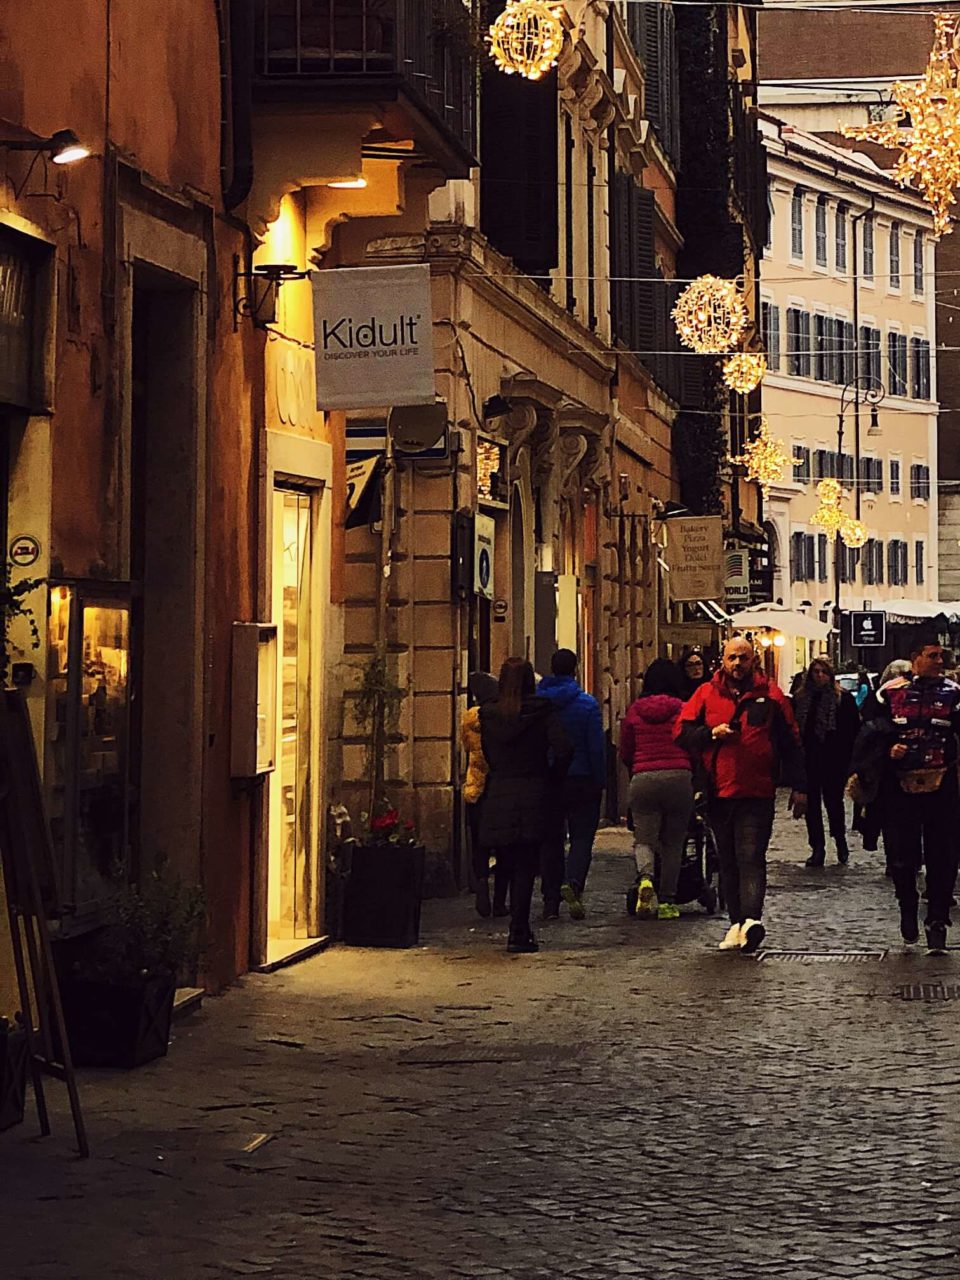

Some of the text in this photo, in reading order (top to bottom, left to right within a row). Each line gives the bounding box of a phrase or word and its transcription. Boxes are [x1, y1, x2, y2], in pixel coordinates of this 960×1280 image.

[322, 315, 418, 350] Kidult
[324, 347, 419, 361] DISCOVER YOUR LIFE
